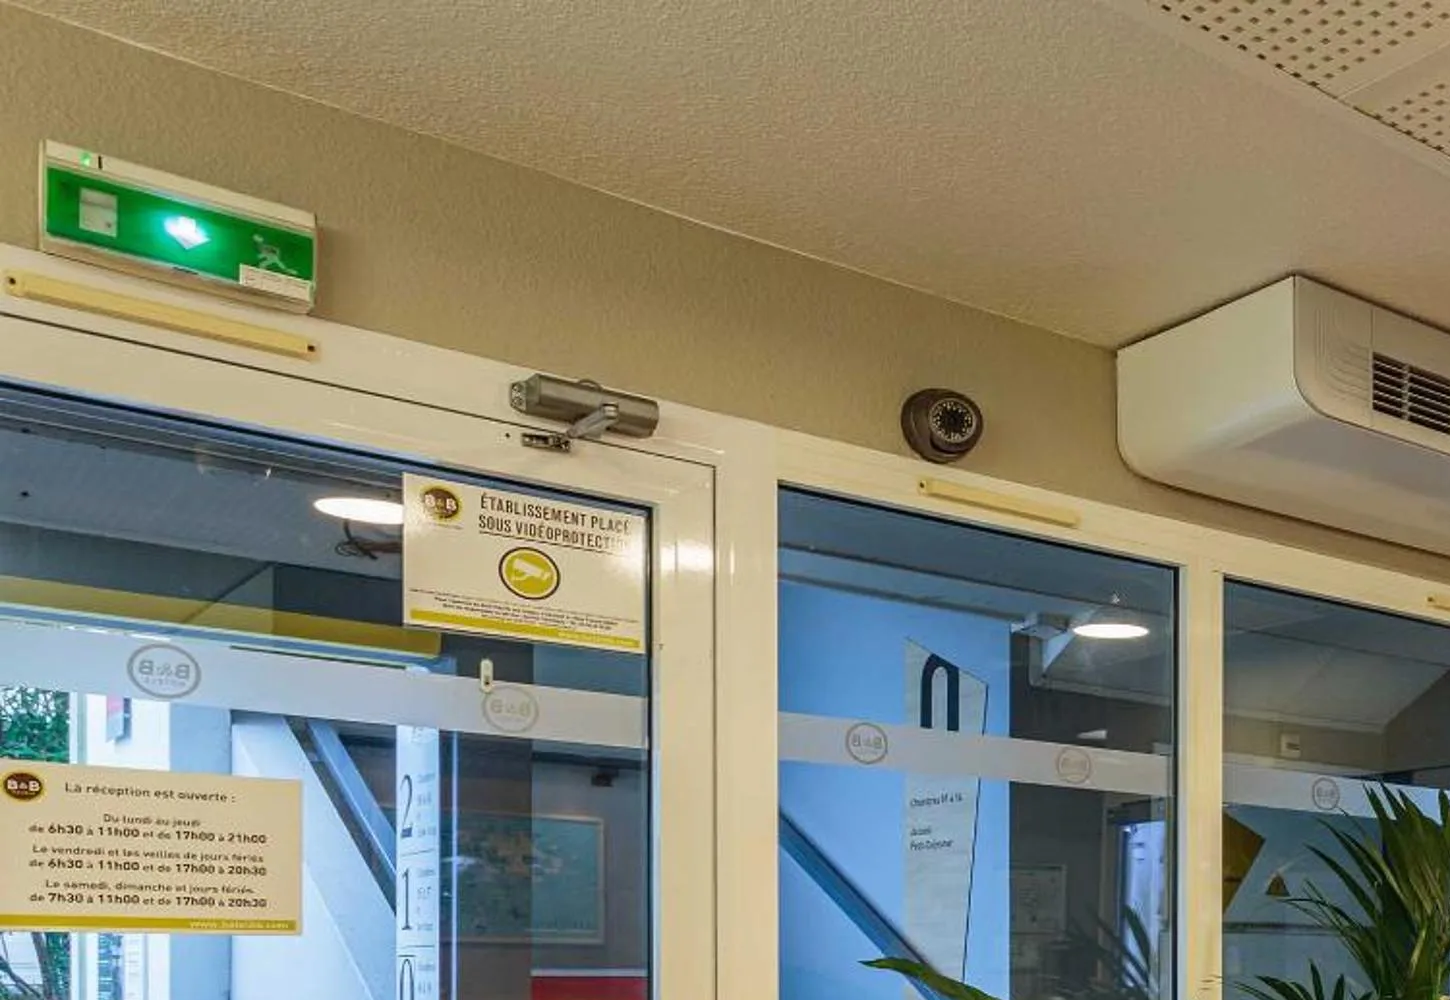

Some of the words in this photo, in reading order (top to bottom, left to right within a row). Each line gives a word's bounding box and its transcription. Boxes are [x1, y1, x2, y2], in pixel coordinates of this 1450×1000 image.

[480, 492, 586, 526] ÉTABLISSEMENT
[478, 515, 512, 533] SOUS
[65, 782, 82, 793] La
[86, 784, 150, 799] réception
[154, 789, 175, 799] est
[178, 791, 228, 803] ouverte
[399, 774, 413, 838] 2
[103, 813, 120, 823] Du
[123, 815, 152, 825] lundi
[48, 824, 84, 835] 6h30
[98, 826, 140, 838] 11h00
[175, 831, 215, 842] 17h00
[227, 833, 268, 845] 21h00
[51, 845, 106, 857] vendredi
[48, 859, 84, 870] 6h30
[98, 860, 140, 872] 11h00
[175, 863, 215, 875] 17h00
[227, 865, 268, 877] 20h30
[115, 881, 173, 893] dimanche
[29, 892, 46, 903] de
[48, 892, 84, 904] 7h30
[98, 893, 140, 906] 11h00
[175, 895, 215, 908] 17h00
[227, 897, 268, 909] 20h30
